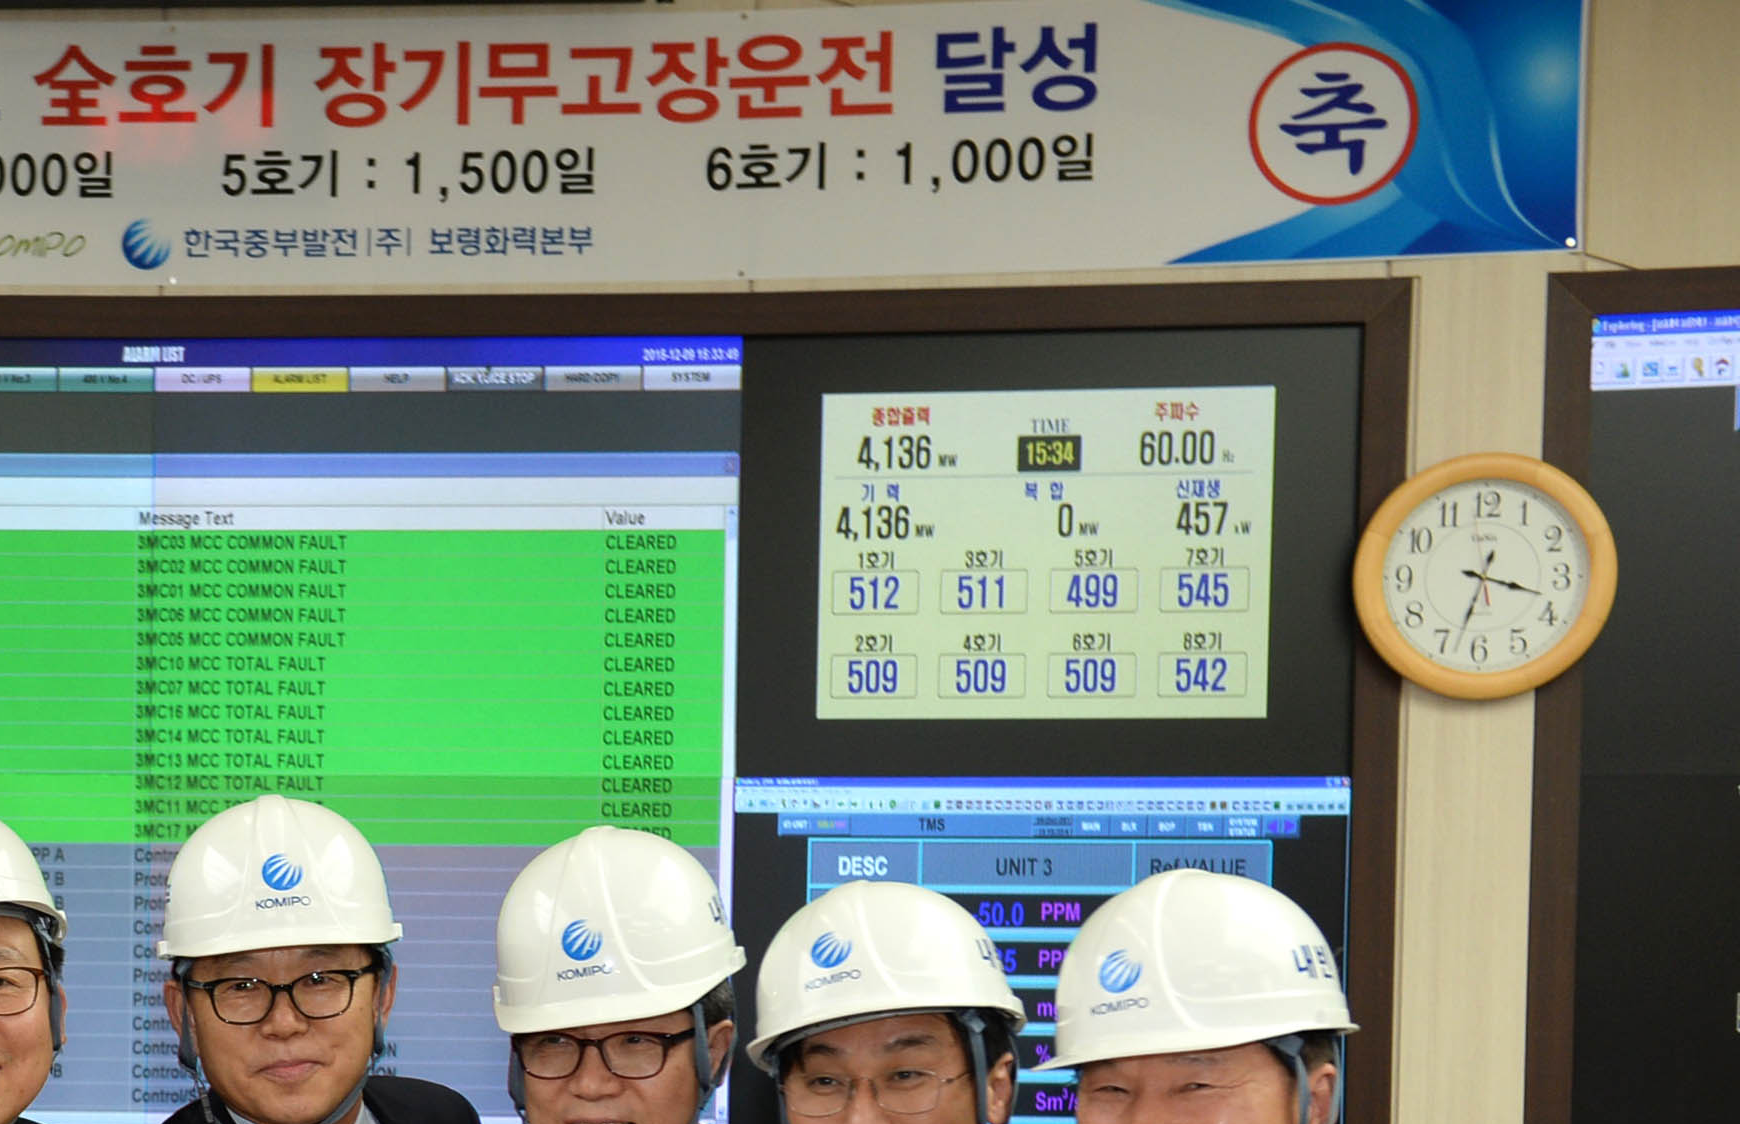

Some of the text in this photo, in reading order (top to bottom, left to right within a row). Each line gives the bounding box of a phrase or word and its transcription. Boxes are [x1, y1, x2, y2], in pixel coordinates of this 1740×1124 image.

[32, 44, 276, 128] 全호기
[314, 35, 895, 128] 장기무고장운전
[934, 21, 1100, 113] 달성
[1278, 71, 1388, 173] 축
[221, 147, 340, 198] 5호기
[705, 141, 828, 193] 6호기
[184, 226, 359, 260] 한국중부발전
[428, 224, 594, 257] 보령화력본부
[1154, 402, 1199, 421] 주파수
[1031, 418, 1071, 434] TIME
[857, 435, 931, 470] 4,136
[1026, 440, 1075, 466] 15:34
[1139, 430, 1215, 466] 60.00
[1175, 479, 1221, 499] 신재생
[1438, 500, 1459, 527] 11
[1475, 491, 1501, 519] 12
[1520, 501, 1529, 526] 1
[139, 511, 234, 530] Message Text
[605, 511, 646, 526] Value
[836, 504, 910, 541] 4,136
[1058, 502, 1073, 538] 0
[1176, 501, 1229, 537] 457
[190, 535, 222, 550] MCC
[227, 535, 294, 550] COMMON
[299, 535, 347, 550] FAULT
[605, 535, 677, 550] CLEARED
[1409, 528, 1433, 554] 10
[1544, 526, 1563, 552] 2
[605, 560, 677, 575] CLEARED
[857, 550, 895, 569] 1호기
[964, 549, 1004, 569] 3호기
[1074, 548, 1114, 568] 5호기
[1186, 547, 1225, 567] 7호기
[1395, 565, 1414, 593] 9
[1552, 562, 1571, 591] 3
[848, 575, 900, 610] 512
[957, 575, 1005, 610] 511
[1066, 573, 1119, 609] 499
[1177, 573, 1229, 608] 545
[604, 609, 676, 624] CLEARED
[1404, 602, 1424, 629] 8
[1538, 601, 1557, 627] 4
[855, 634, 893, 653] 2호기
[963, 633, 1002, 653] 4호기
[1072, 632, 1112, 652] 6호기
[1183, 631, 1223, 651] 8호기
[1433, 629, 1451, 655] 7
[1470, 637, 1488, 664] 6
[1510, 629, 1528, 655] 5
[188, 656, 220, 671] MCC
[226, 656, 273, 671] TOTAL
[278, 656, 326, 671] FAULT
[603, 657, 675, 672] CLEARED
[847, 659, 898, 694] 509
[955, 659, 1006, 693] 509
[1064, 658, 1117, 693] 509
[1175, 657, 1227, 693] 542
[603, 682, 675, 697] CLEARED
[602, 755, 674, 770] CLEARED
[918, 817, 946, 832] TMS
[838, 856, 888, 877] DESC
[995, 857, 1053, 877] UNIT 3
[255, 894, 312, 911] KOMIPO
[1041, 902, 1081, 922] PPM
[804, 968, 862, 991] KOMIPO
[1090, 996, 1150, 1016] KOMIPO
